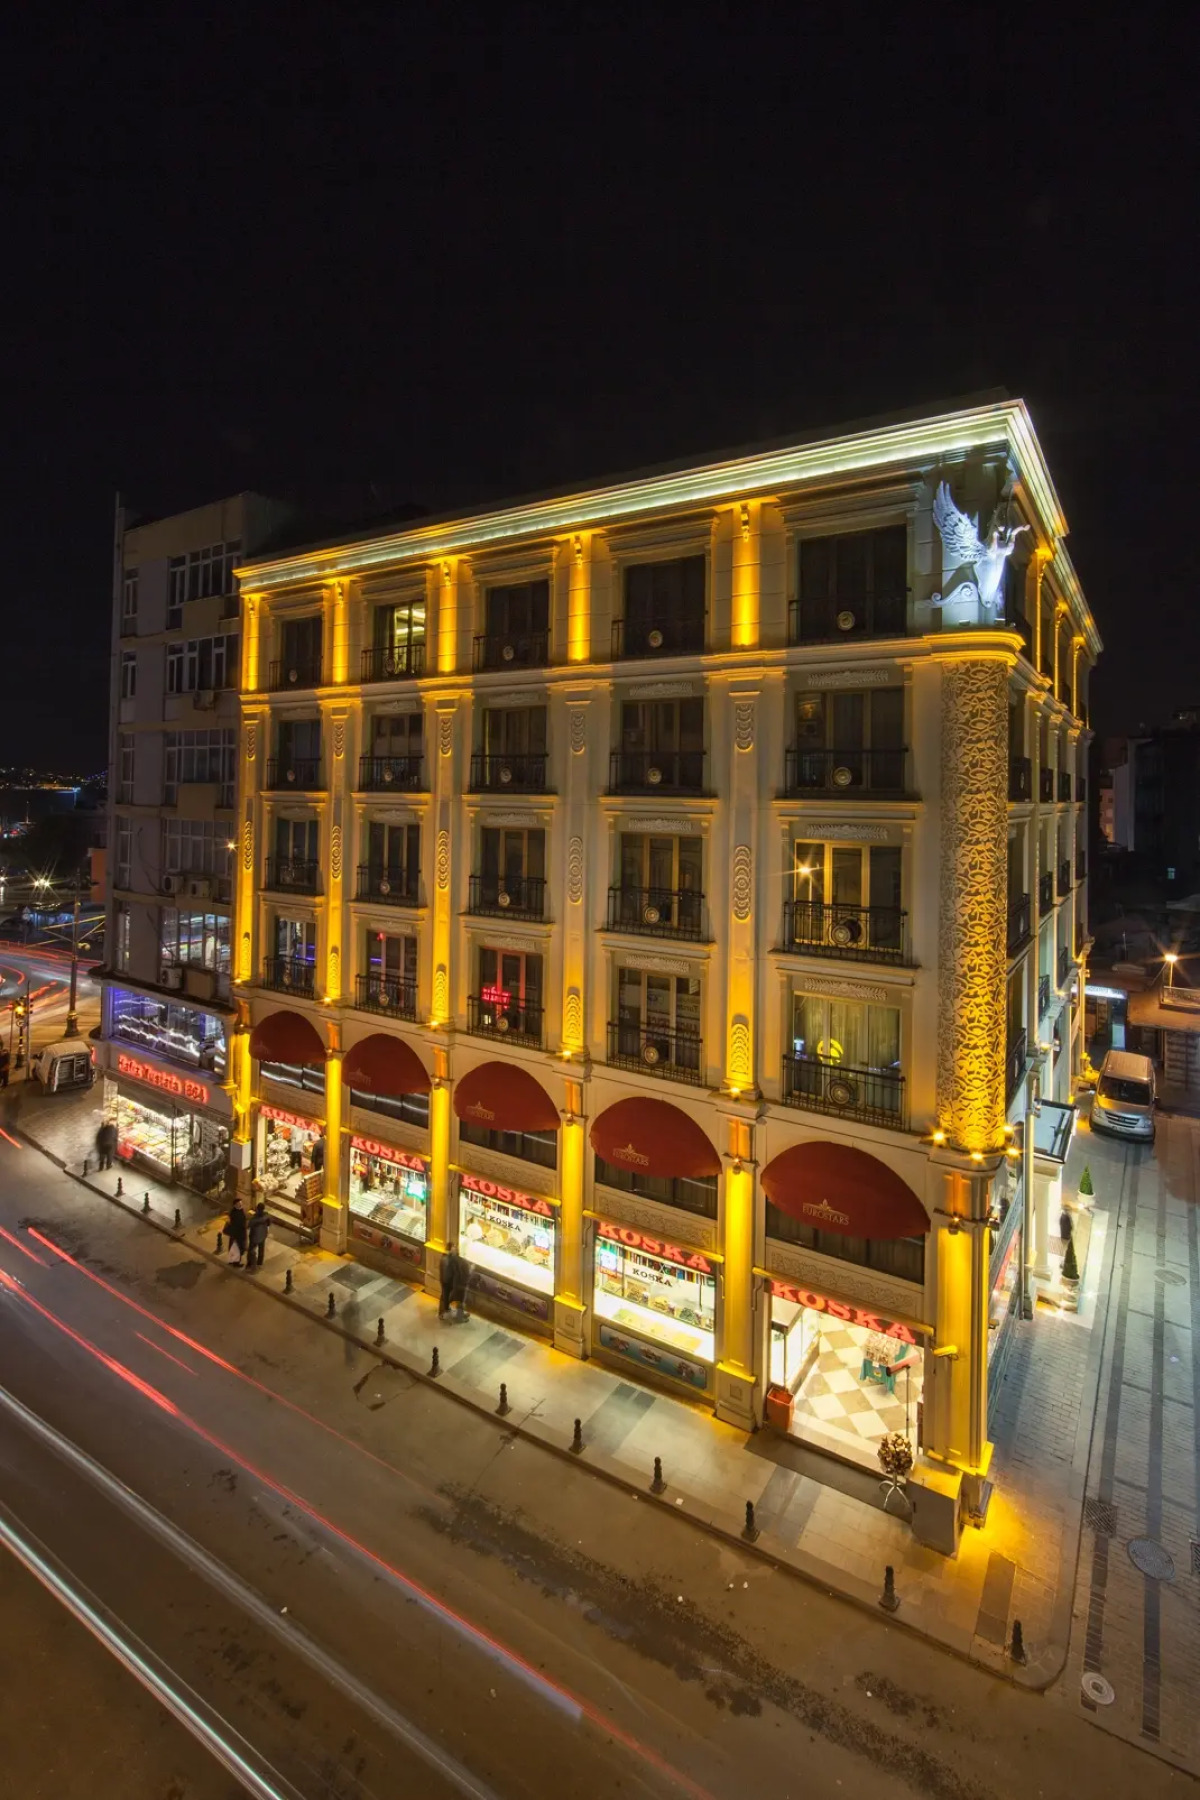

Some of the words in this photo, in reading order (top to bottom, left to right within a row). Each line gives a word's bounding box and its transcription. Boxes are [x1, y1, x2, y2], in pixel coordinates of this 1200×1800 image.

[351, 1136, 425, 1172] KOSKA
[461, 1174, 552, 1216] KOSKA
[488, 1215, 522, 1232] KOSKA
[802, 1206, 850, 1226] EUROSTARS
[598, 1222, 712, 1272] KOSKA
[632, 1268, 673, 1287] KOSKA
[771, 1281, 916, 1344] KOSKA
